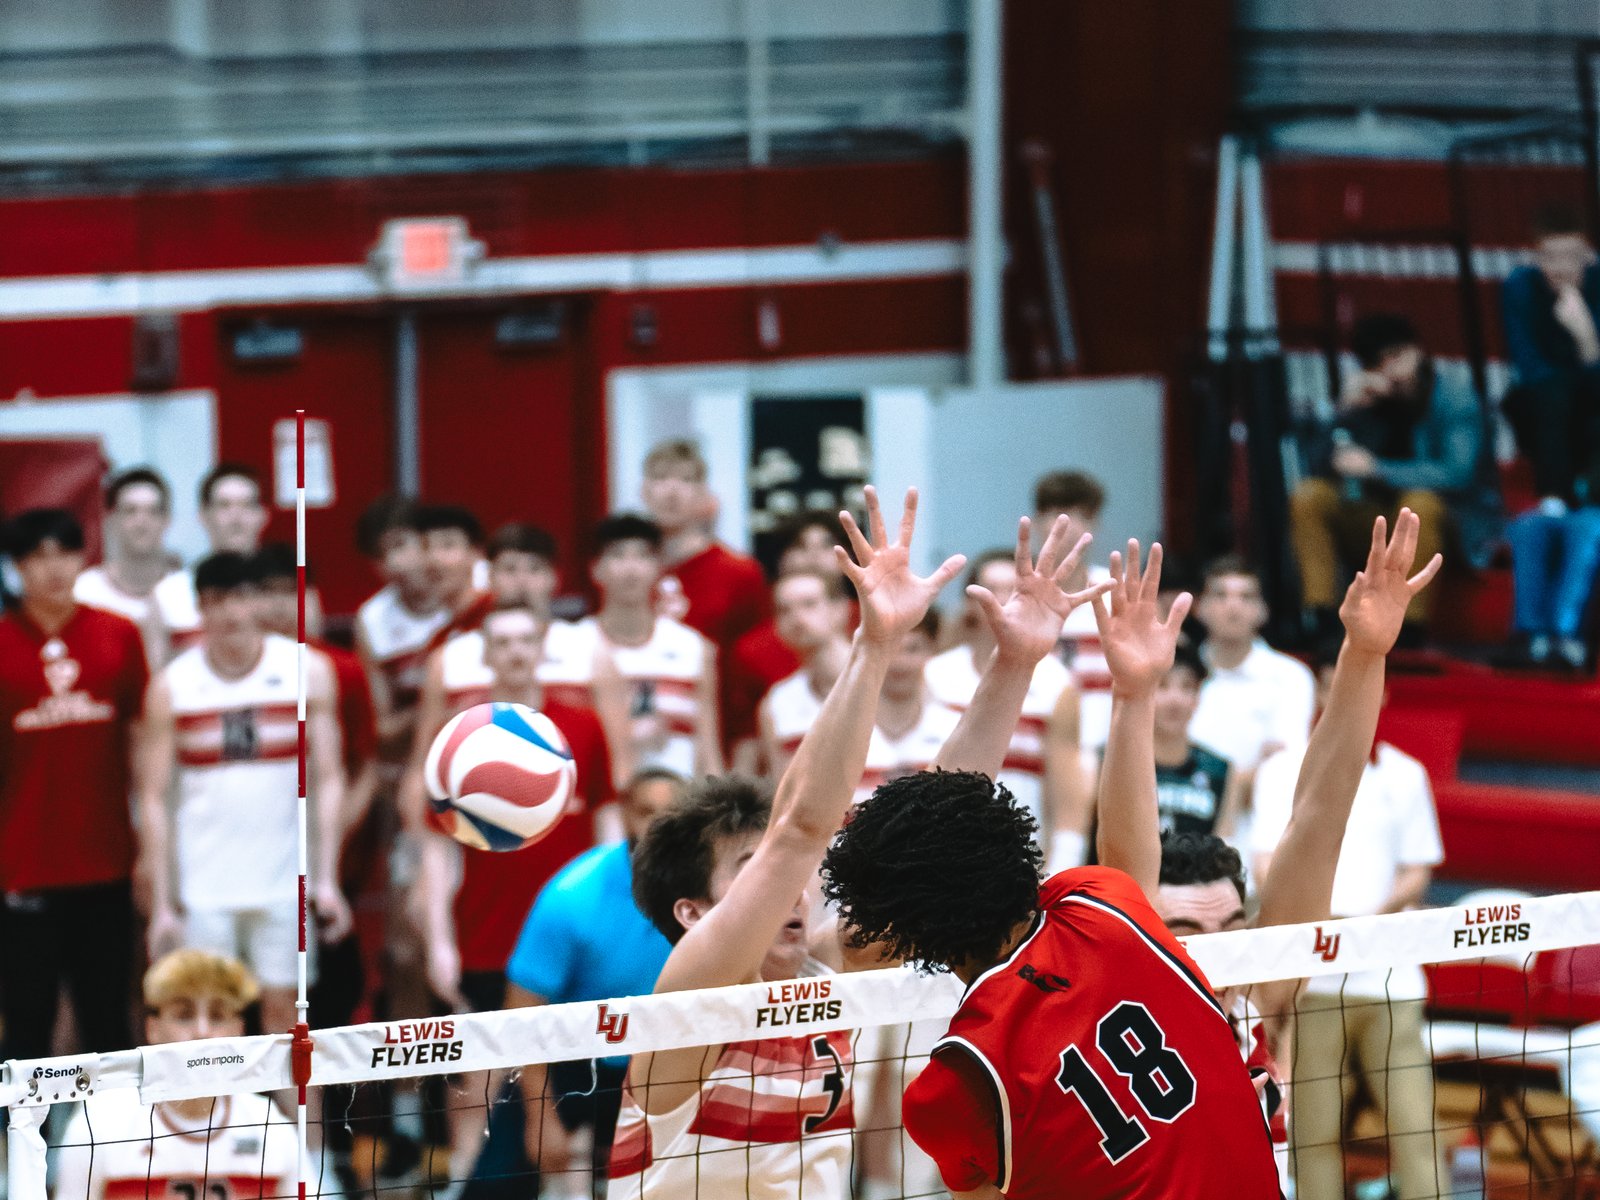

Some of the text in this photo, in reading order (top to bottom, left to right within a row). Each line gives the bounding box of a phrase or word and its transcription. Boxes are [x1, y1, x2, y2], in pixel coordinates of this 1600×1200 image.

[1464, 903, 1522, 926] LEWIS
[1312, 926, 1342, 963] LU
[1453, 922, 1531, 949] FLYERS
[767, 980, 832, 1004] LEWIS
[595, 1003, 630, 1045] LU
[756, 999, 843, 1028] FLYERS
[384, 1020, 455, 1045] LEWIS
[186, 1056, 210, 1069] sports
[371, 1040, 464, 1069] FLYERS
[44, 1064, 83, 1079] Senoh
[1054, 999, 1197, 1166] 18
